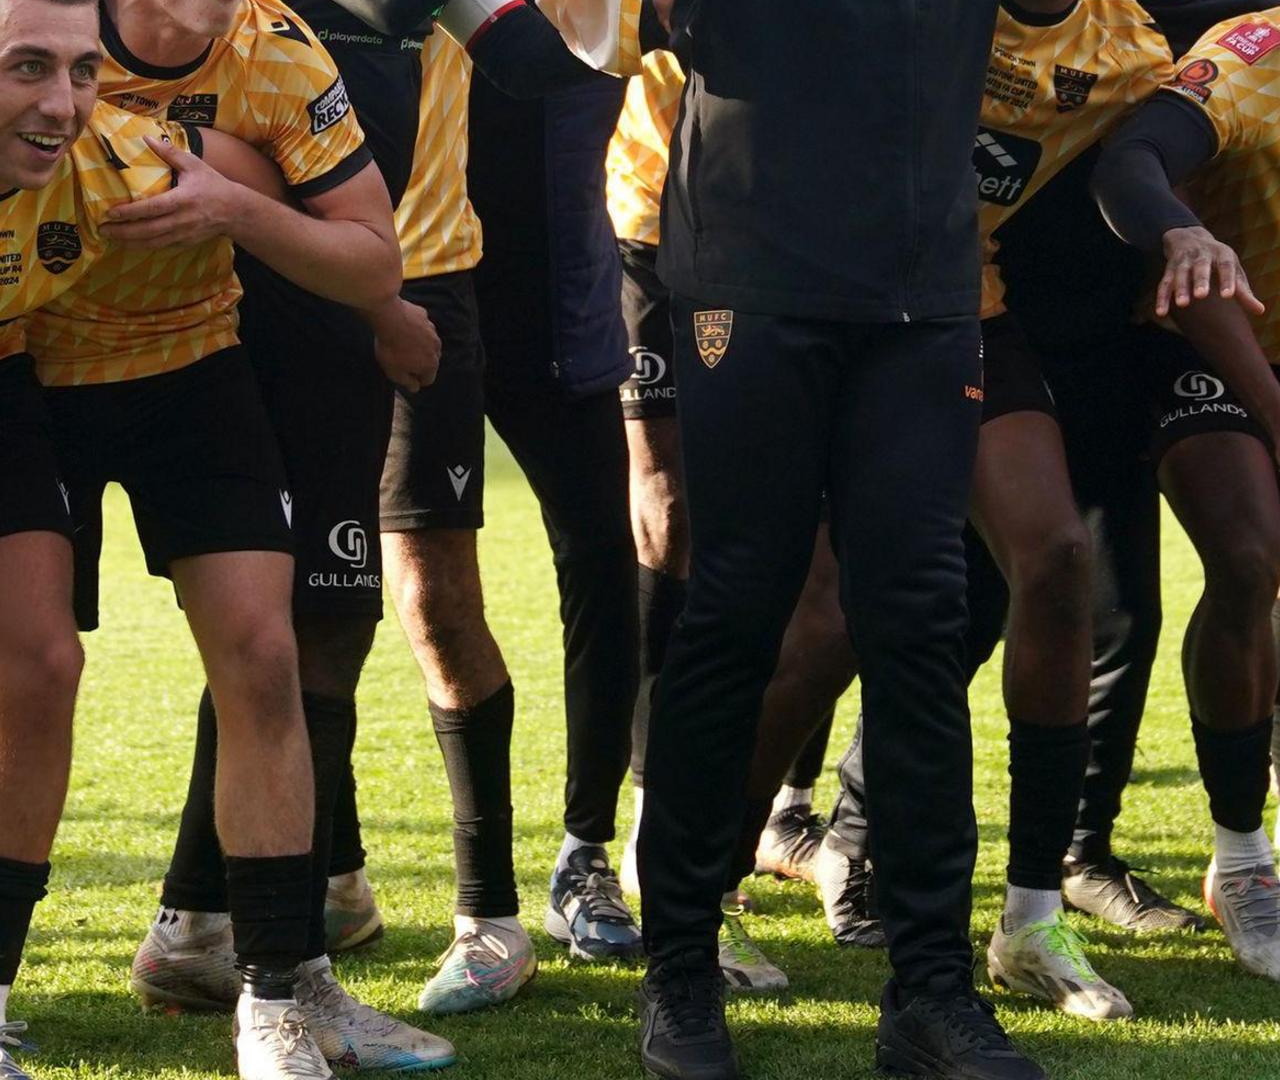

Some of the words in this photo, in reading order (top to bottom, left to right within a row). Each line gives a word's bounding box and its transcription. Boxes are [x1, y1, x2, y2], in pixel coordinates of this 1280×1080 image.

[329, 31, 383, 45] playerdata
[1236, 42, 1256, 56] CUP
[135, 95, 160, 110] TOWN
[1160, 403, 1248, 428] GULLANDS
